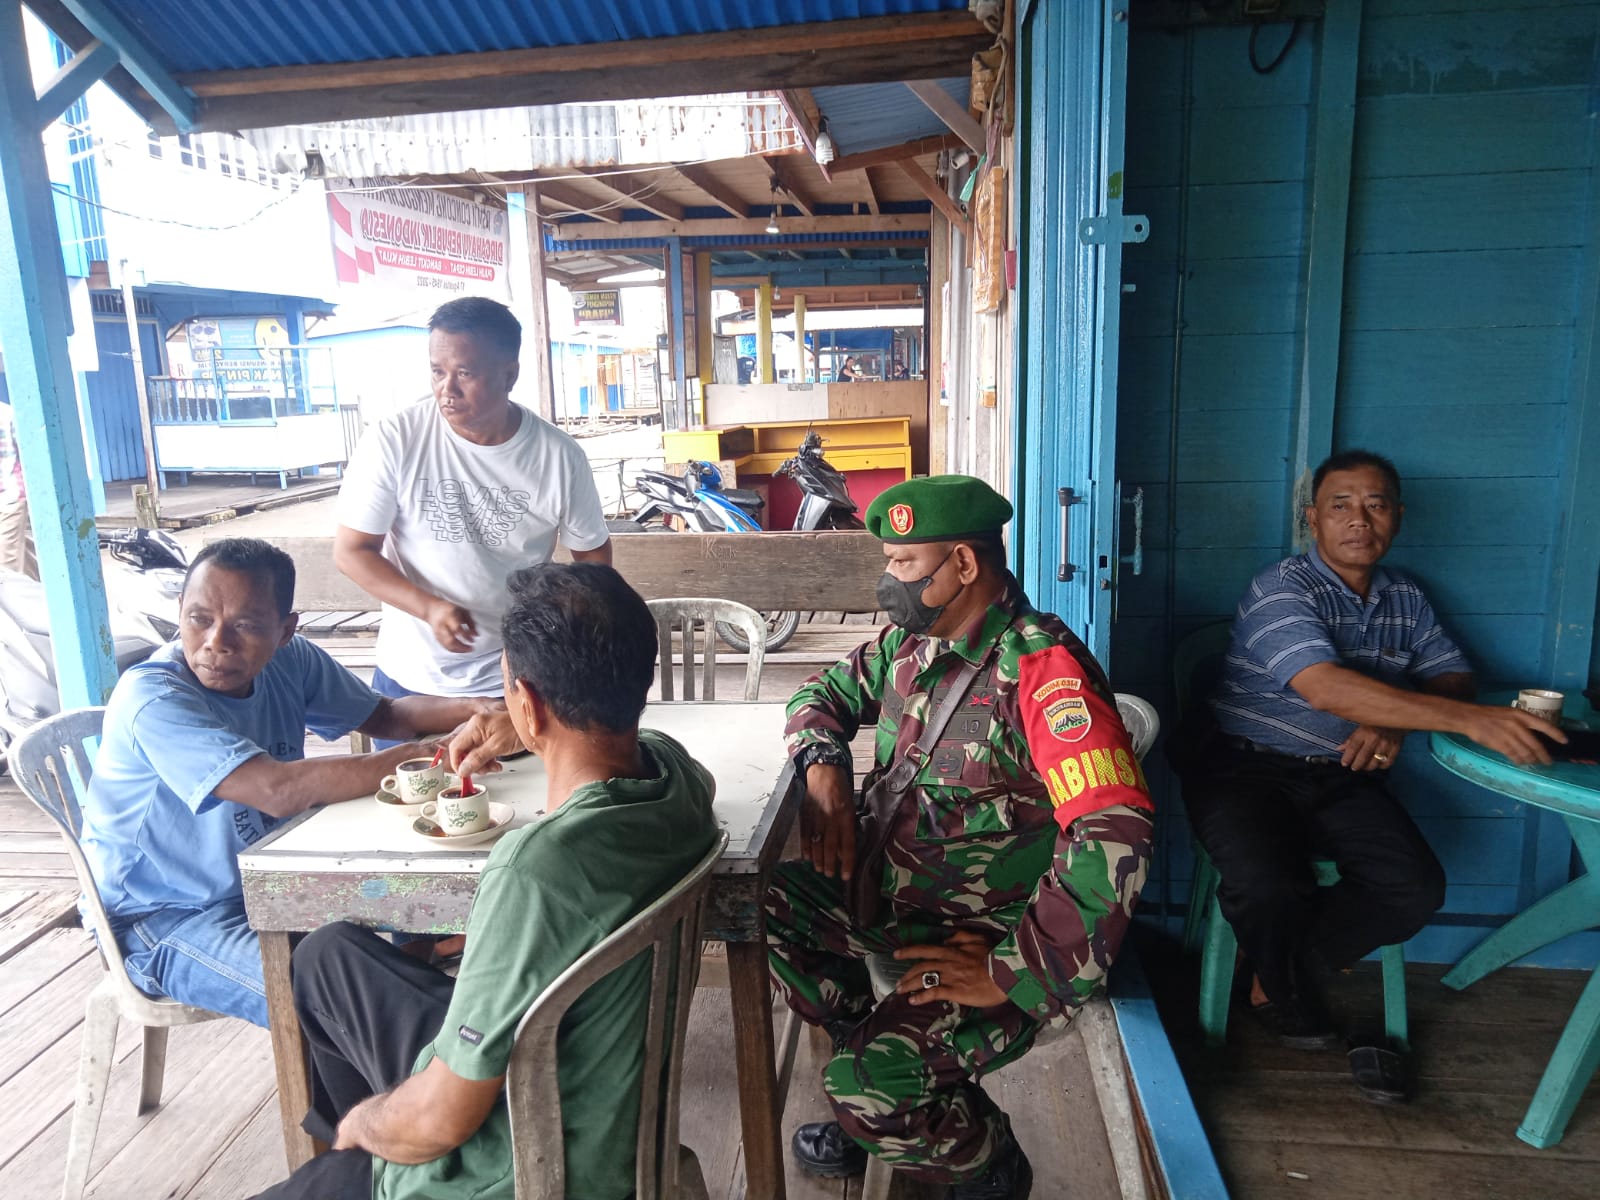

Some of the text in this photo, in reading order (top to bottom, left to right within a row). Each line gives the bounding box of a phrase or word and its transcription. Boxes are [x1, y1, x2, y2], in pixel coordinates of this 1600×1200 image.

[419, 478, 530, 514] Levi's
[1036, 680, 1061, 700] KODIM
[1044, 748, 1149, 809] ABINS
